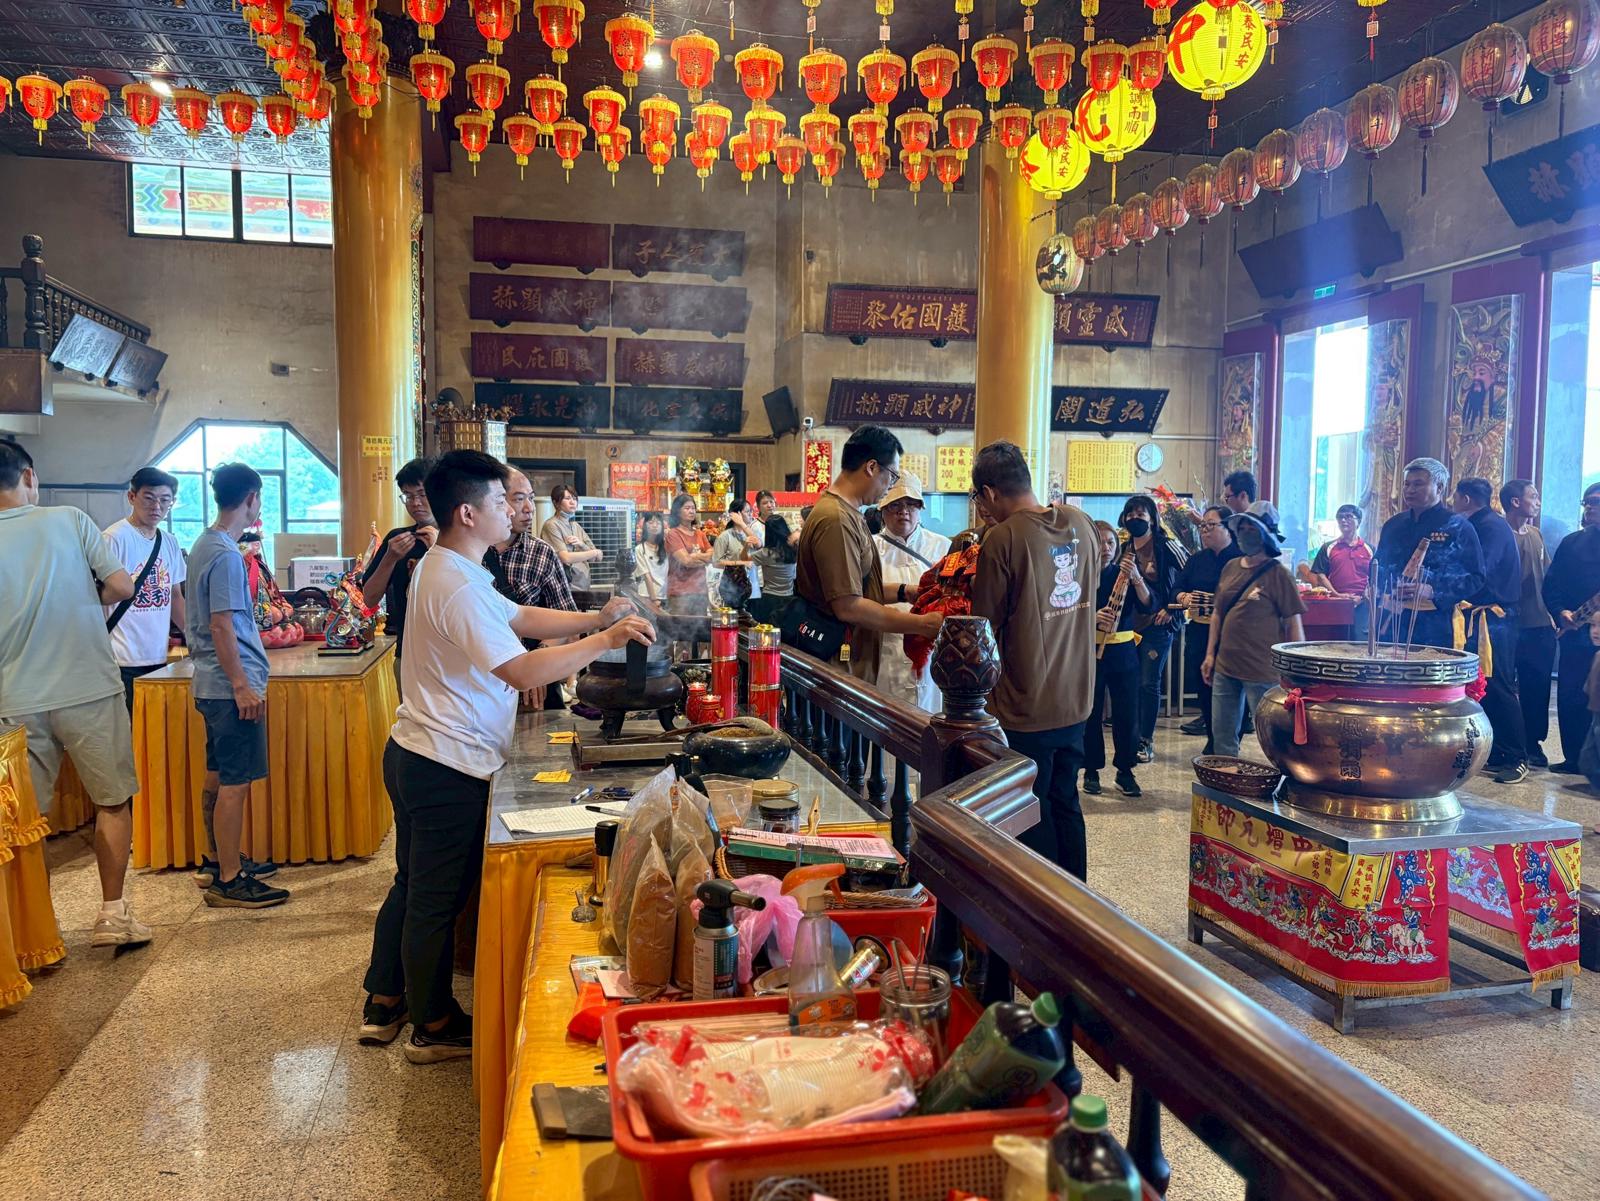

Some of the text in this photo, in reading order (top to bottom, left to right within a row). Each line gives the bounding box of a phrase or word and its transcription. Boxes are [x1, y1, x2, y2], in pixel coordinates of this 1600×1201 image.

[862, 299, 970, 334] 護國佑黎
[855, 391, 963, 420] 神威顯赫
